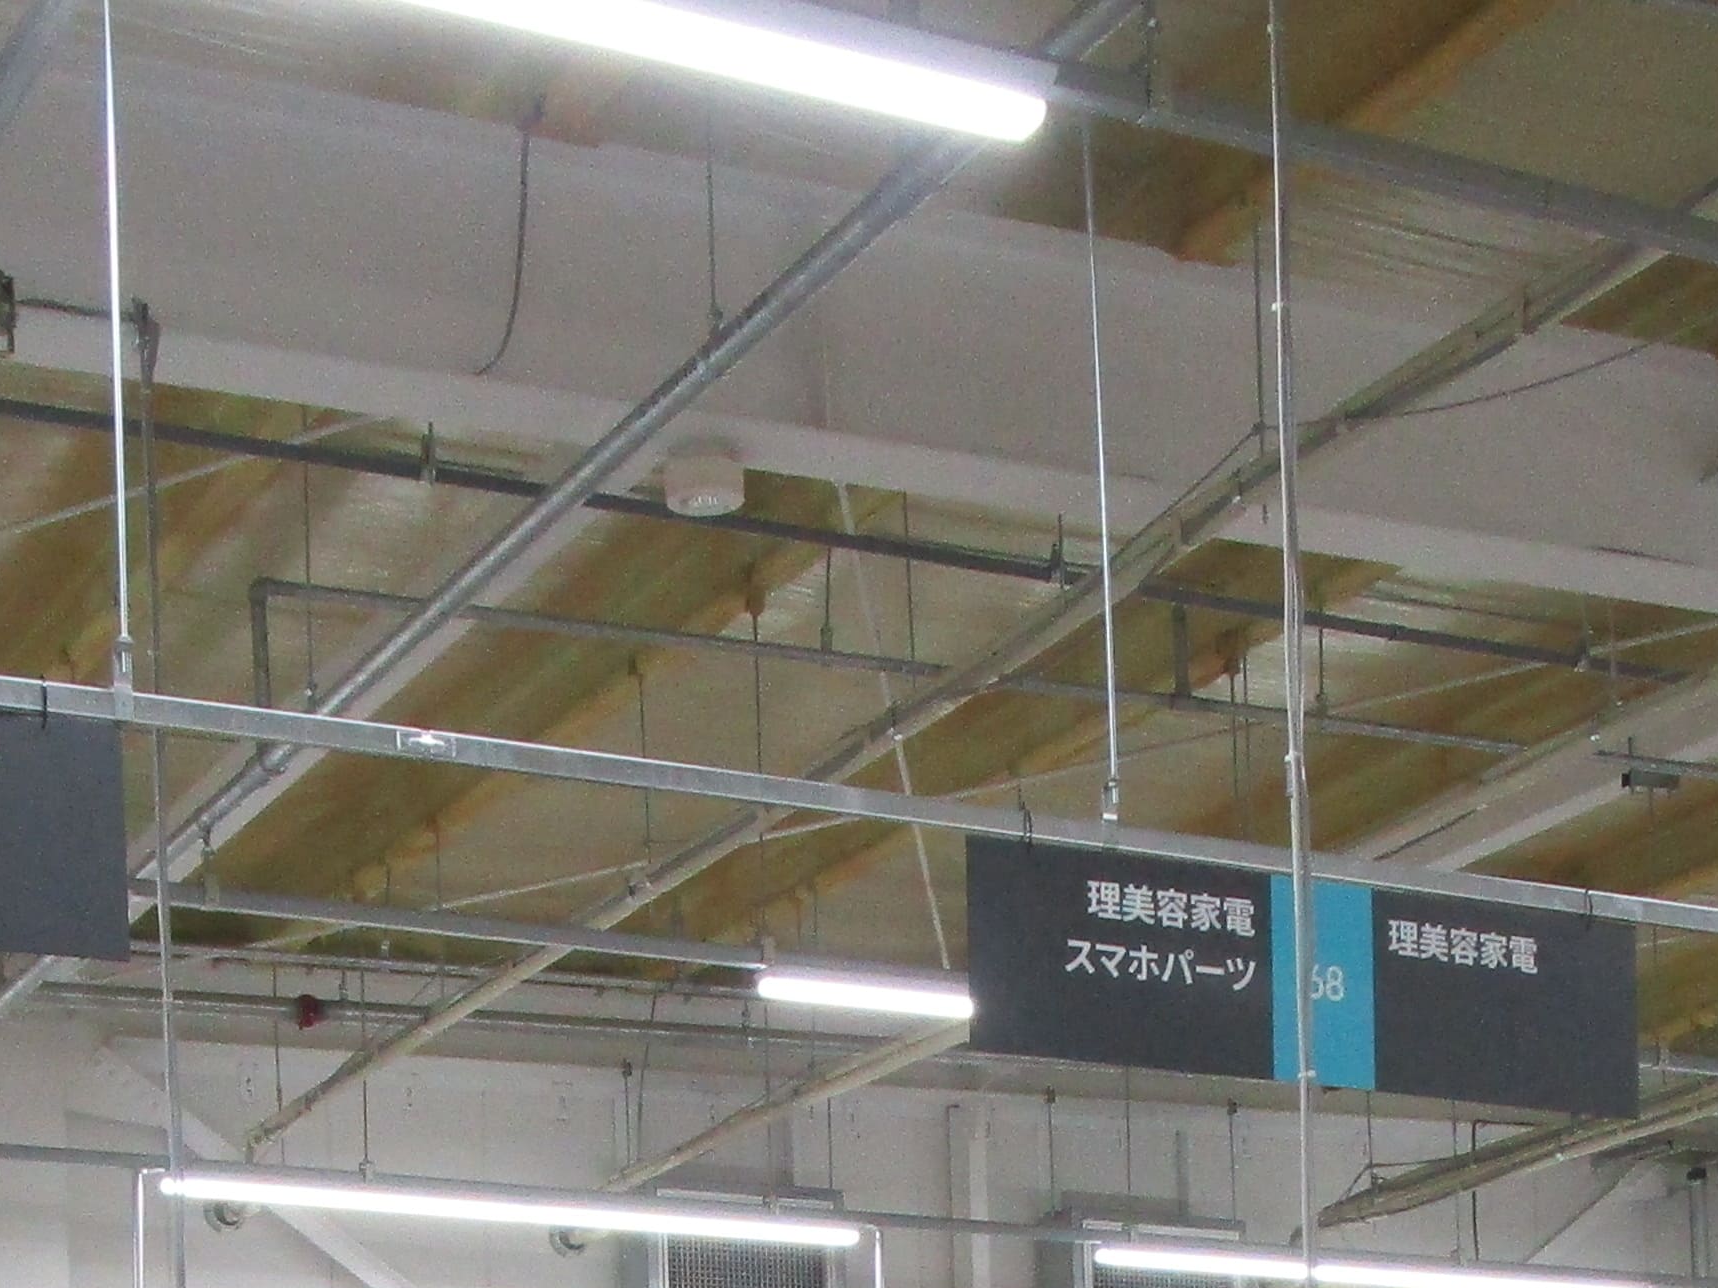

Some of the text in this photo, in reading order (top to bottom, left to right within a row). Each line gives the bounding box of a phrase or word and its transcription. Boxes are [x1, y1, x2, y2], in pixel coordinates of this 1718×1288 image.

[1087, 879, 1256, 938] 理美容家電
[1064, 937, 1257, 992] スマホパーツ
[1388, 919, 1539, 975] 理美容家電
